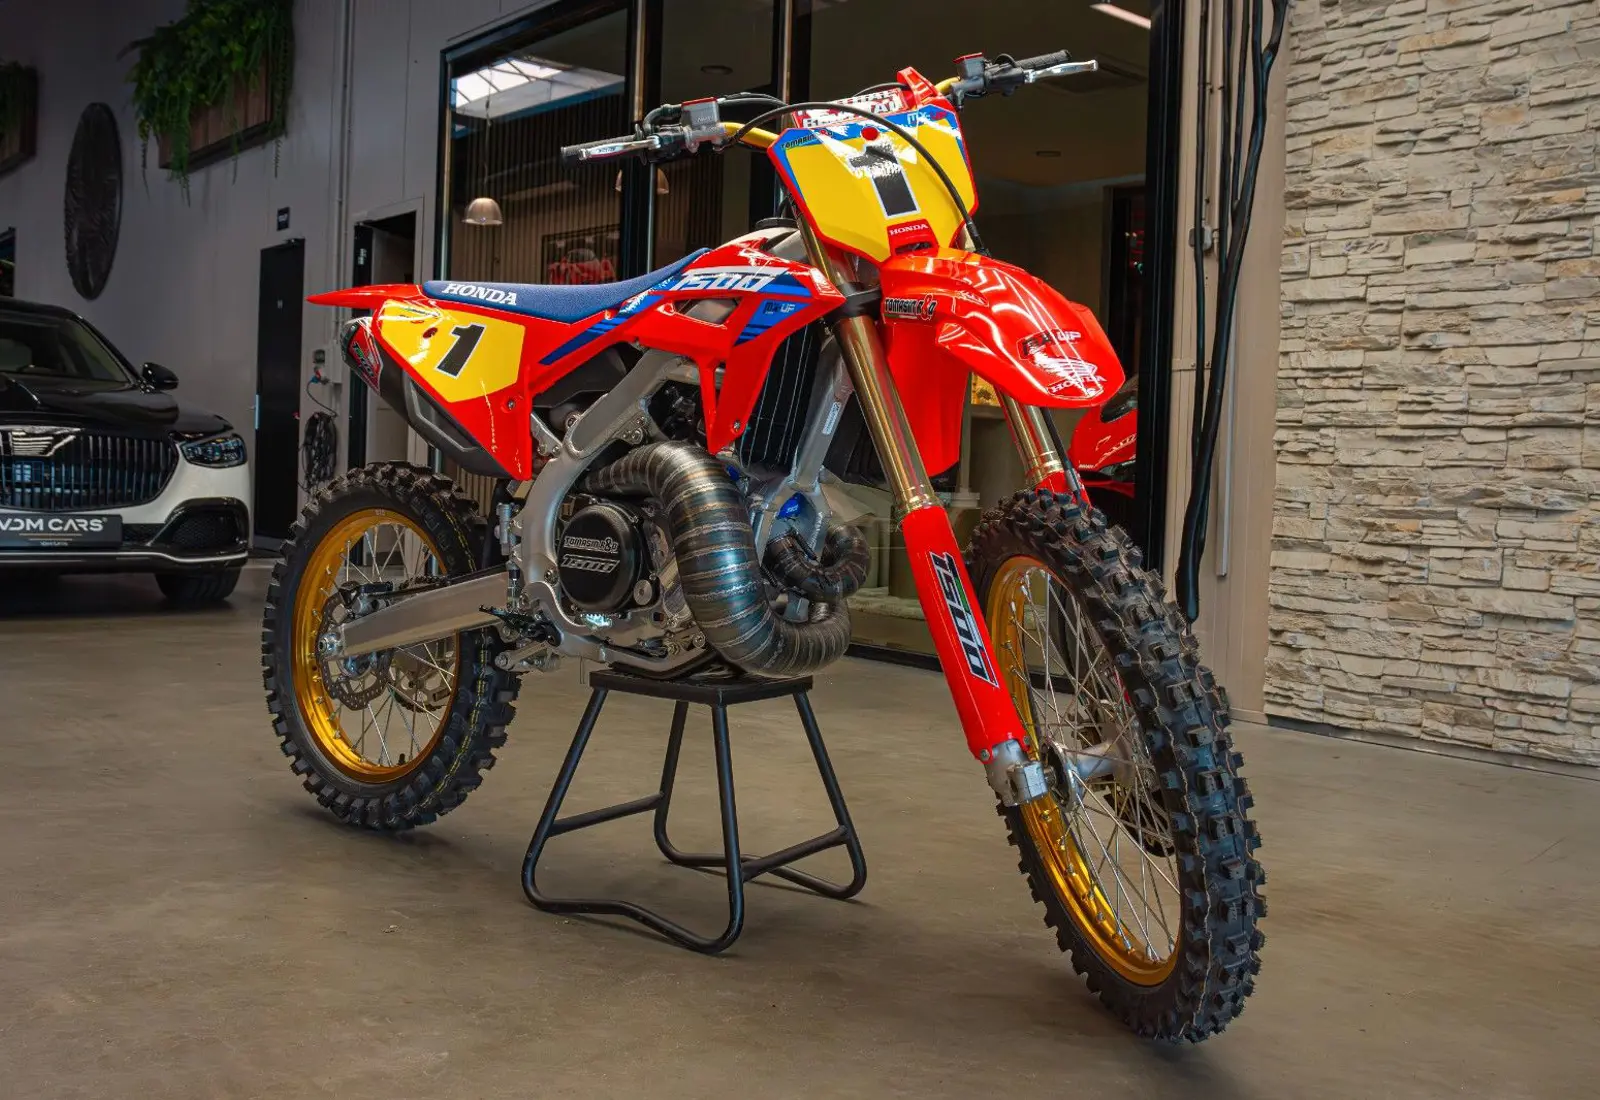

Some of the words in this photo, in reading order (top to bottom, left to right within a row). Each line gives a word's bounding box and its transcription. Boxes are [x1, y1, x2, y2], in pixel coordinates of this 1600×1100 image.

[848, 142, 921, 219] 1
[888, 223, 929, 236] HONDA
[441, 283, 517, 306] HONDA
[434, 322, 487, 380] 1
[0, 518, 44, 531] VDM
[48, 518, 103, 531] CARS
